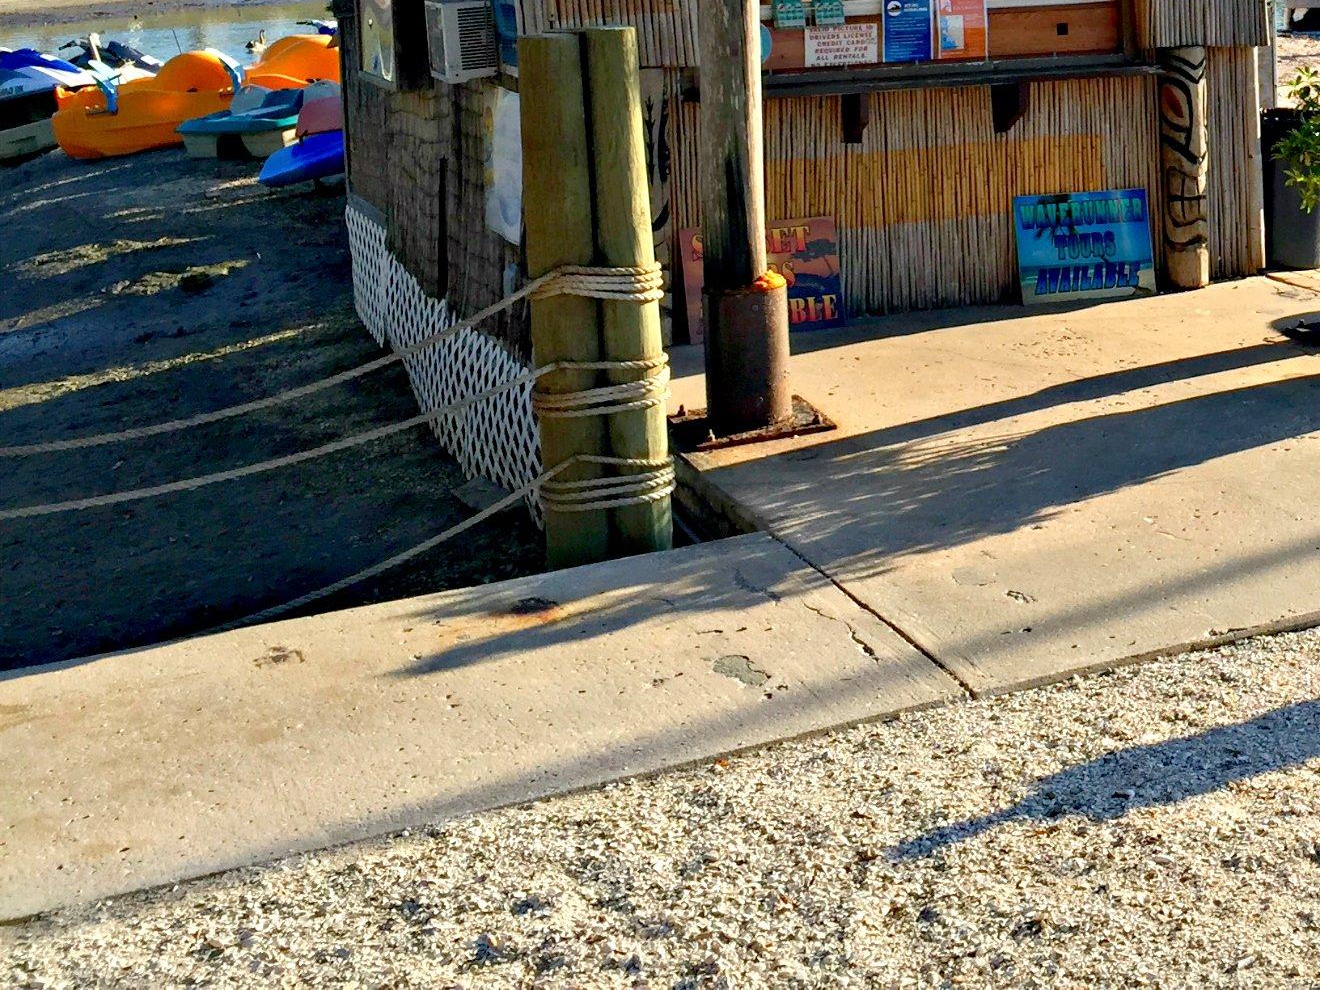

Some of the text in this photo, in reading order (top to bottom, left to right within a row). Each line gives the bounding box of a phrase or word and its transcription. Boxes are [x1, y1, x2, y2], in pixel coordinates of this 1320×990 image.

[1020, 197, 1144, 230] WAVERUNNER
[1053, 230, 1116, 260] TOURS
[1035, 260, 1141, 295] AVAILABLE
